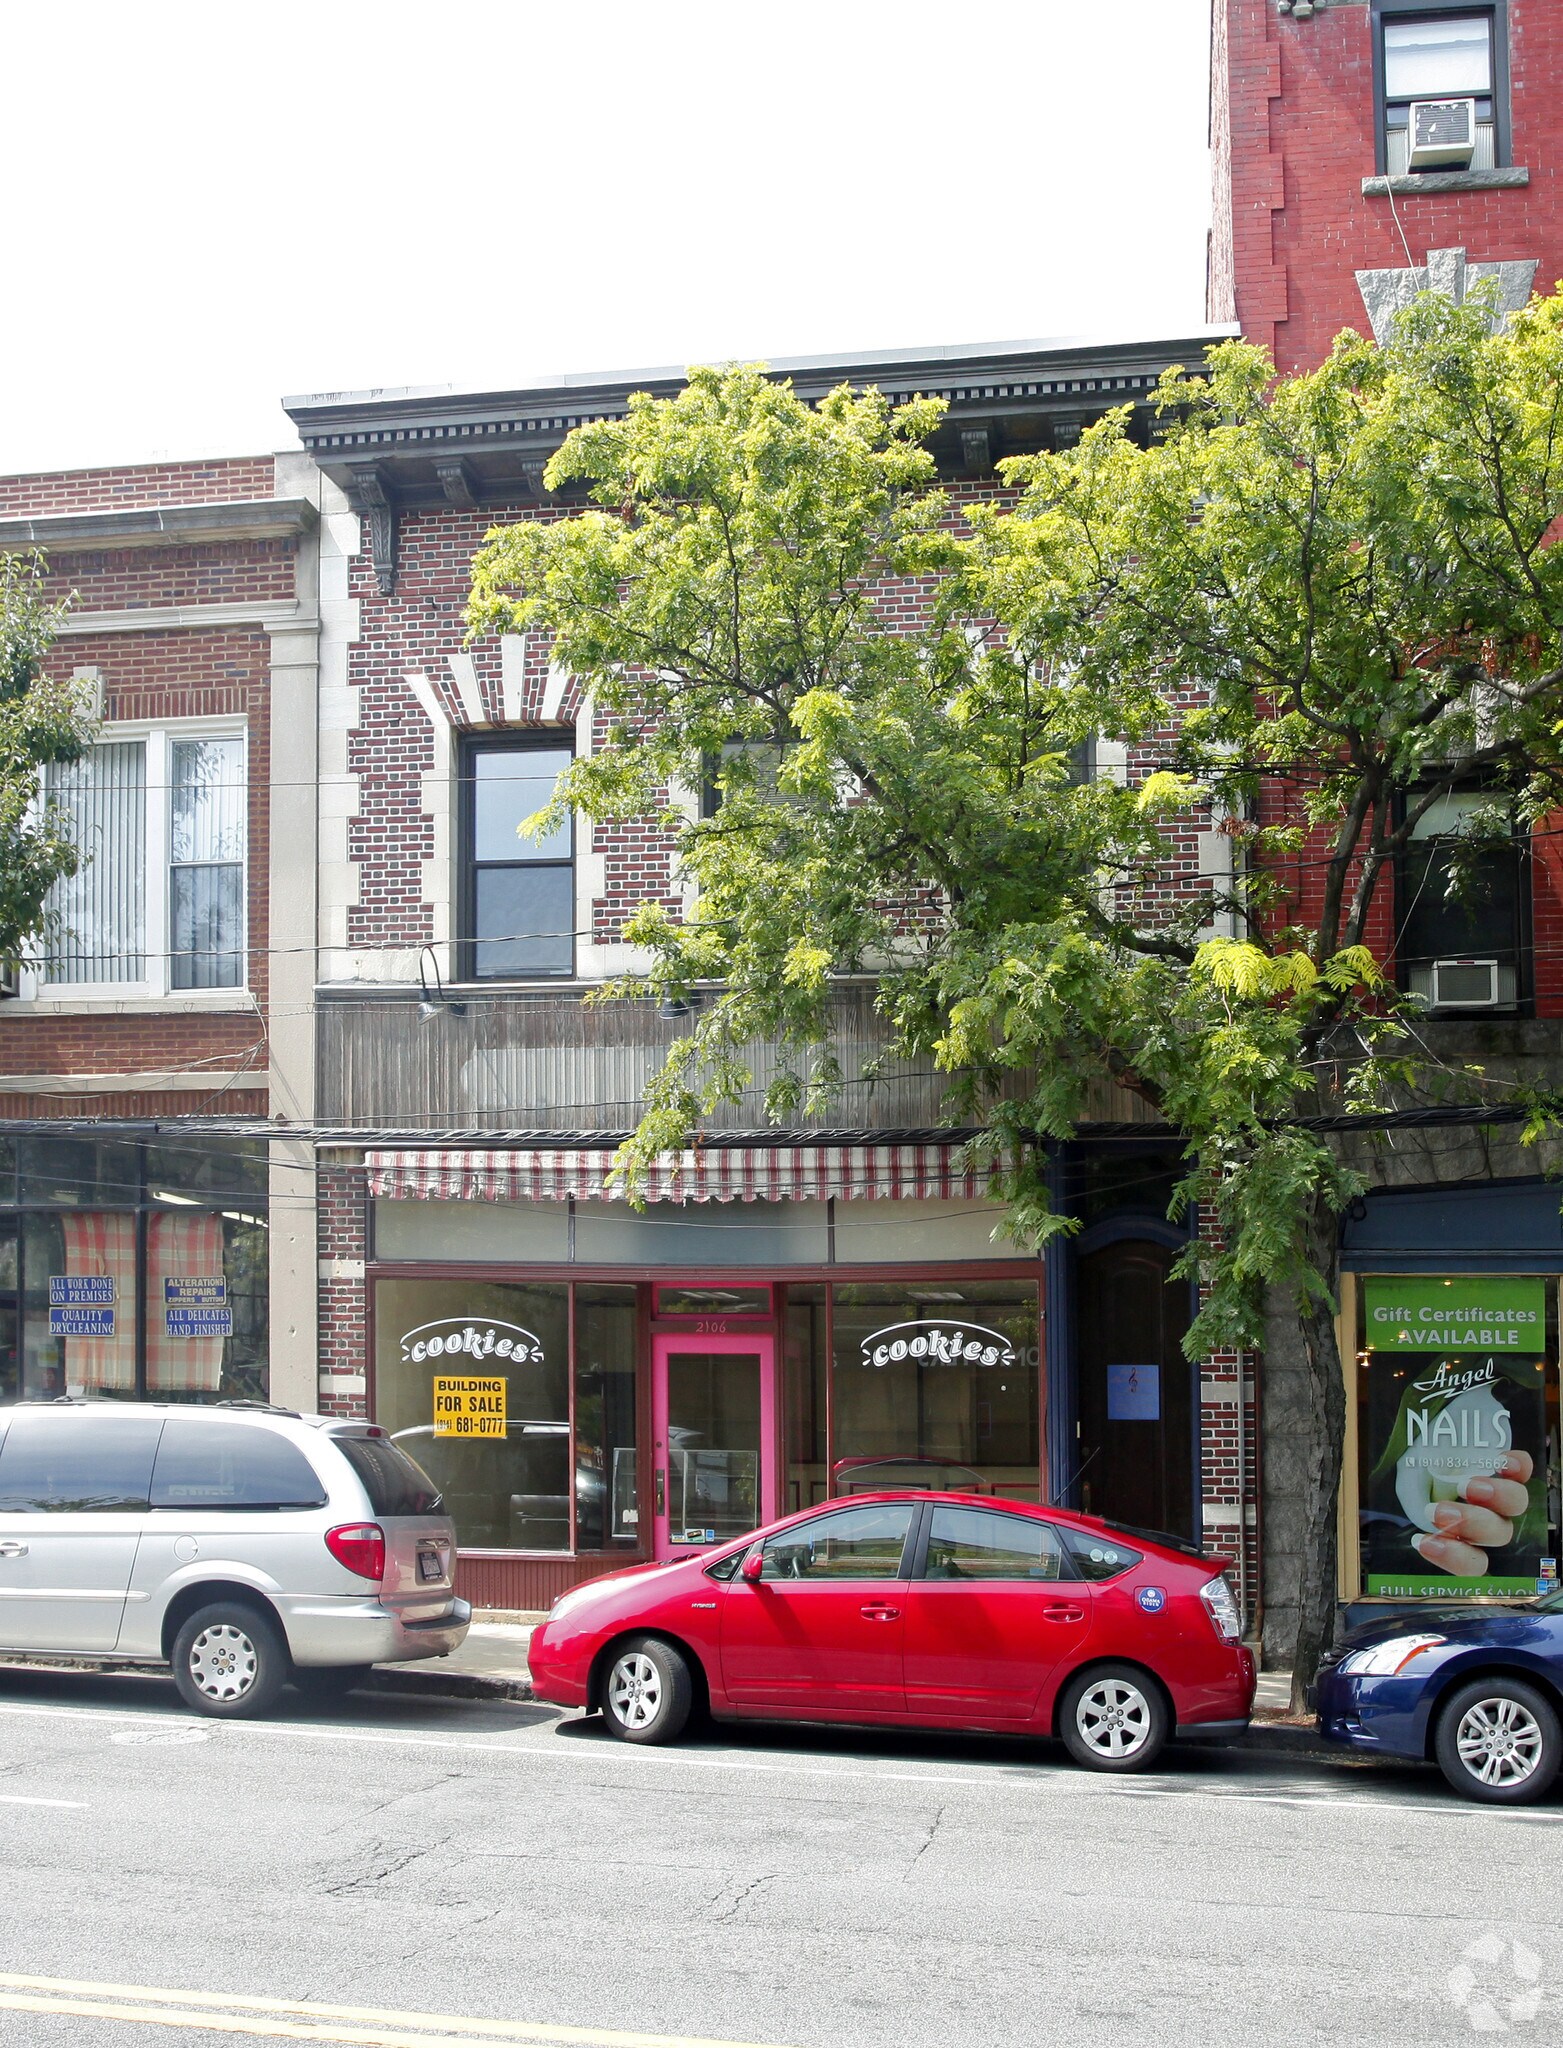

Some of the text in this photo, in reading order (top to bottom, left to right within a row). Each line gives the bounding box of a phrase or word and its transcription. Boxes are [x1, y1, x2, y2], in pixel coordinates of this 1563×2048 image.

[51, 1279, 113, 1290] ALL WORK DONE
[167, 1279, 224, 1287] ALTERATIONS
[52, 1290, 113, 1302] ON PREMISES
[180, 1287, 217, 1296] REPAIRS
[62, 1310, 103, 1322] QUALITY
[169, 1310, 230, 1321] ALL DELICATES
[1373, 1306, 1537, 1323] Gift Certificates
[50, 1321, 115, 1334] DRYCLEANING
[167, 1323, 232, 1335] HAND FINISHED
[695, 1319, 727, 1333] 2106
[1397, 1329, 1519, 1345] AVAILABLE
[411, 1327, 529, 1363] cookies
[872, 1329, 1000, 1367] cookies
[1413, 1357, 1496, 1392] Angel
[438, 1380, 502, 1392] BUILDING
[437, 1396, 503, 1413] FOR SALE
[456, 1416, 503, 1433] 681-0777
[1407, 1407, 1511, 1447] NAILS
